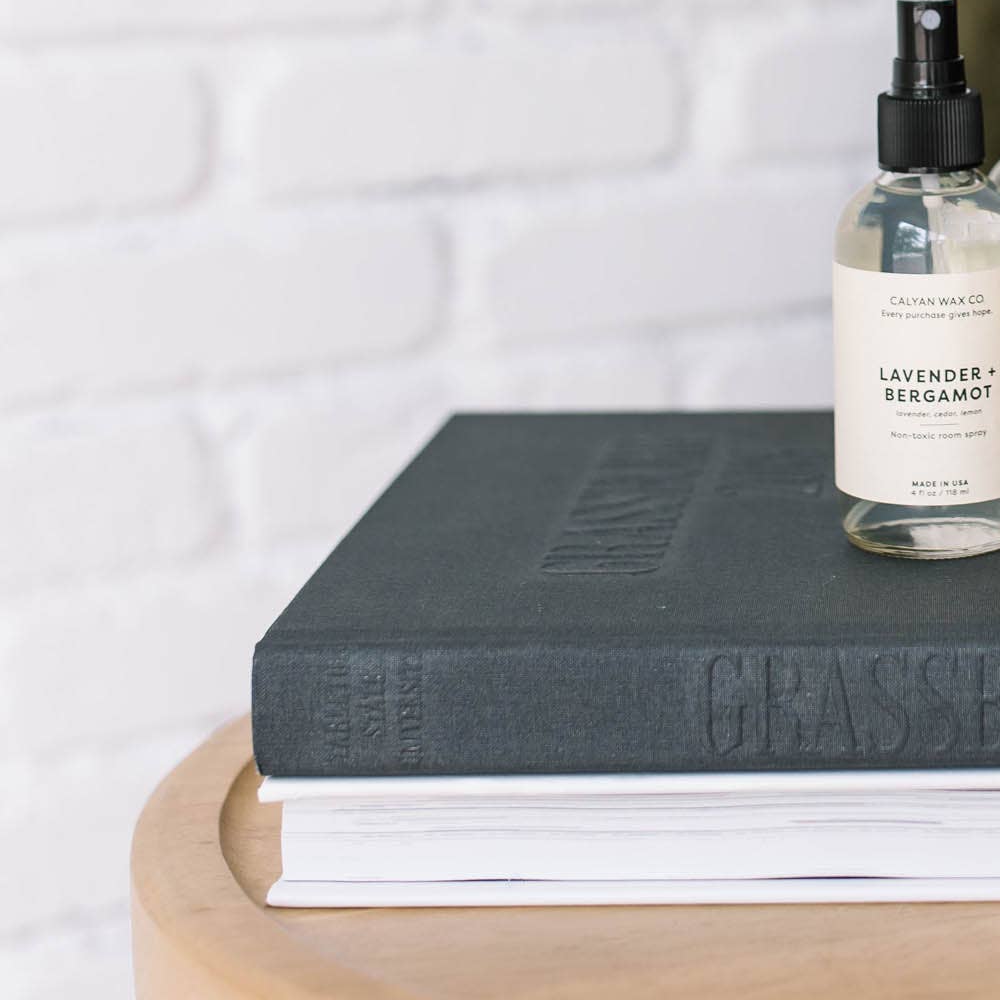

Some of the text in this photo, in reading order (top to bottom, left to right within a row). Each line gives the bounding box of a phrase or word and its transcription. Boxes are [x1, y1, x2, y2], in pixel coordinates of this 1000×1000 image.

[889, 296, 935, 306] CALYAN
[938, 296, 966, 306] WAX
[881, 309, 903, 319] Every
[905, 311, 946, 320] purchase
[948, 311, 970, 320] gives
[880, 367, 997, 383] LAVENDER +
[885, 385, 992, 403] BERGAMOT
[960, 408, 983, 416] lemon
[890, 430, 987, 440] Non-toxic room spray
[952, 479, 969, 487] USA
